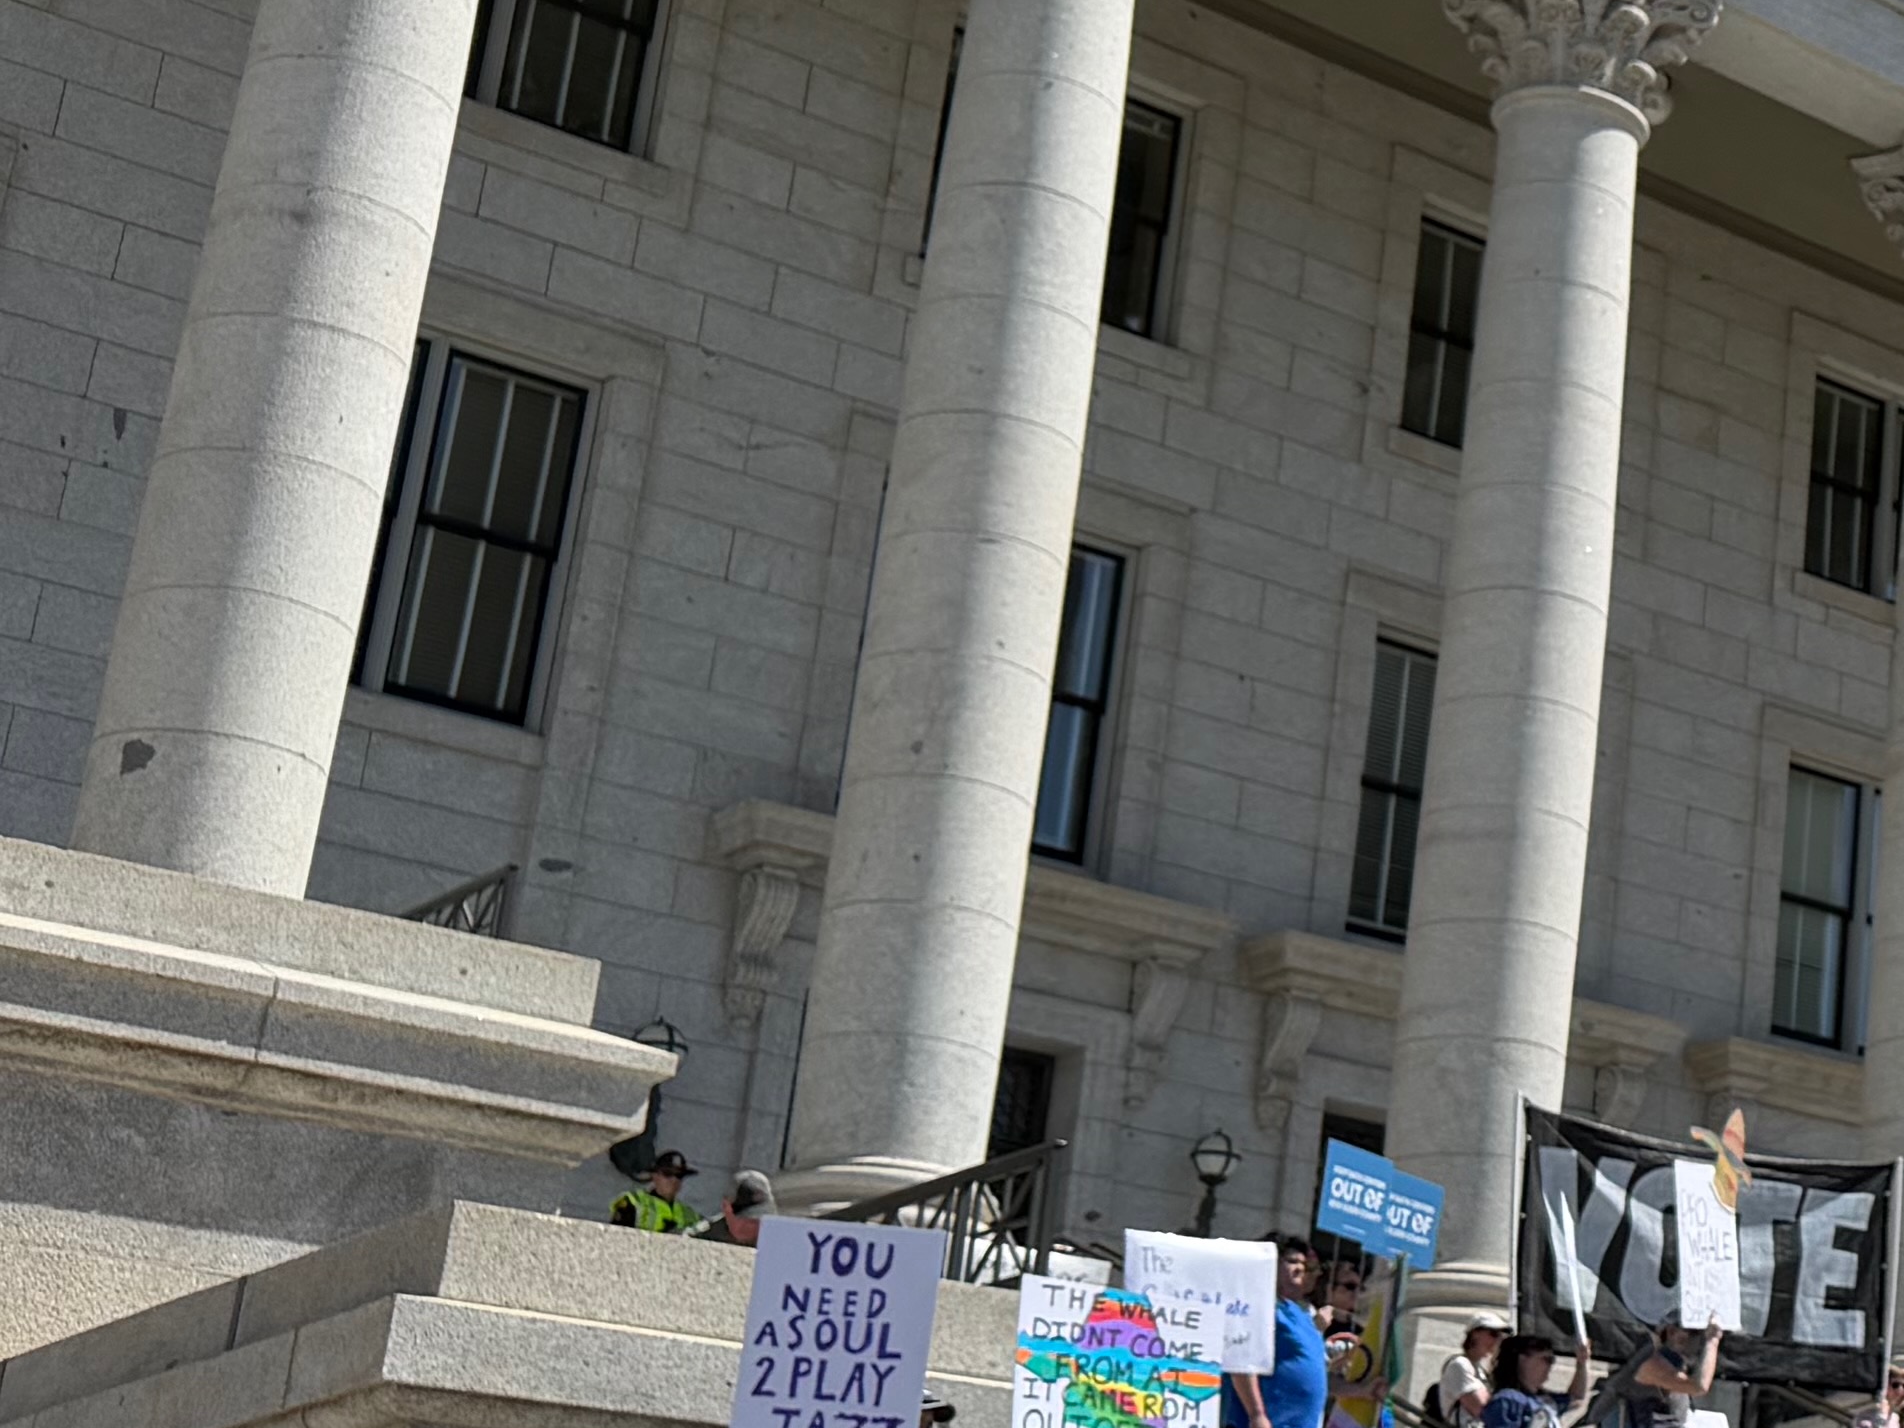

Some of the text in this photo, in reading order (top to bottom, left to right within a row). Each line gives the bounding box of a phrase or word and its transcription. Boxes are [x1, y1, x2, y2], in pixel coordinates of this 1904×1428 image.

[1331, 1177, 1364, 1204] OUT
[1364, 1189, 1385, 1211] OF
[1386, 1205, 1411, 1228] UT
[1412, 1213, 1434, 1236] OF
[808, 1231, 894, 1279] YOU
[1539, 1146, 1875, 1349] VOTE
[782, 1283, 887, 1318] NEED
[1042, 1284, 1106, 1313] THE
[1119, 1298, 1202, 1330] WHALE
[754, 1314, 902, 1360] A SOUL
[1032, 1317, 1124, 1349] DIDNT
[1130, 1333, 1203, 1360] COME
[751, 1356, 896, 1407] 2 PLAY
[1023, 1377, 1051, 1402] IT
[1056, 1353, 1134, 1385] FROM
